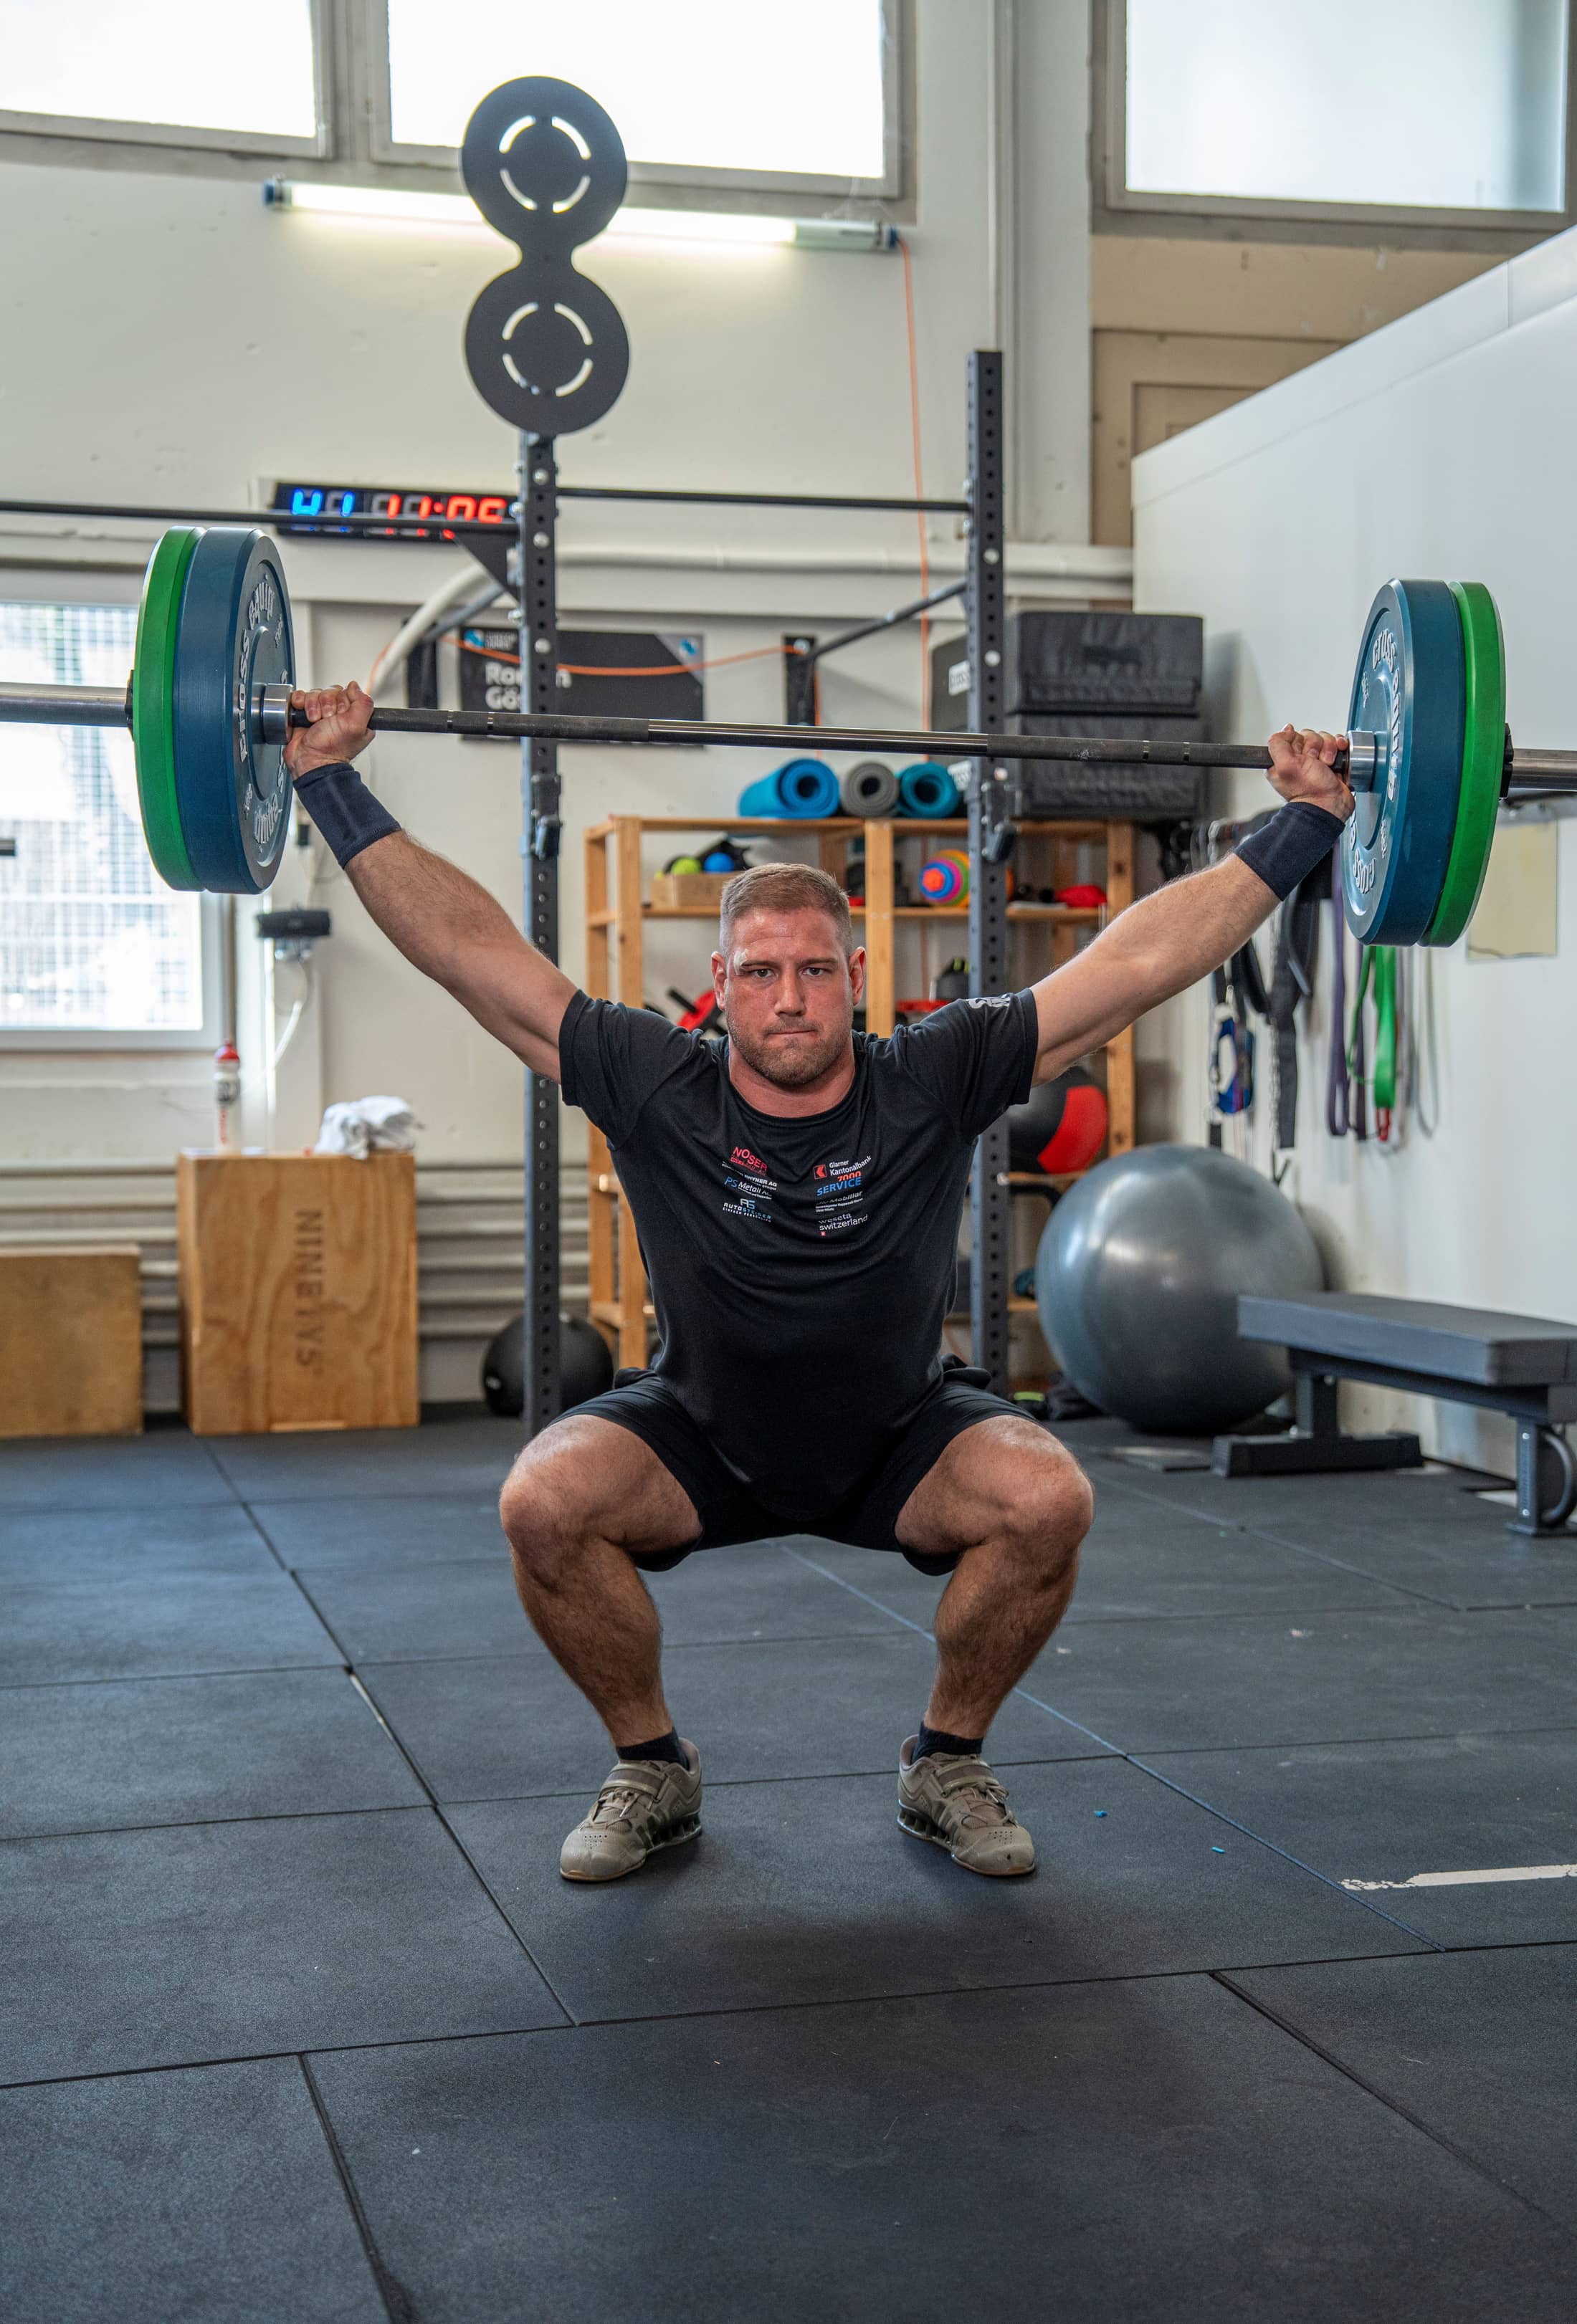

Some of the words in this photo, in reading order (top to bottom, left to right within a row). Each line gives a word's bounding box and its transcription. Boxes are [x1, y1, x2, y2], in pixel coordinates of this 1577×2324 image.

[1372, 628, 1397, 674] cross
[733, 1146, 768, 1171] NOSER
[829, 1159, 849, 1169] Glarner
[829, 1155, 872, 1176] Kantonalbank
[724, 1176, 738, 1187] PS
[738, 1181, 761, 1194] Metall
[816, 1177, 861, 1196] SERVICE
[829, 1191, 863, 1203] Mobiliar
[819, 1214, 868, 1230] switzerland
